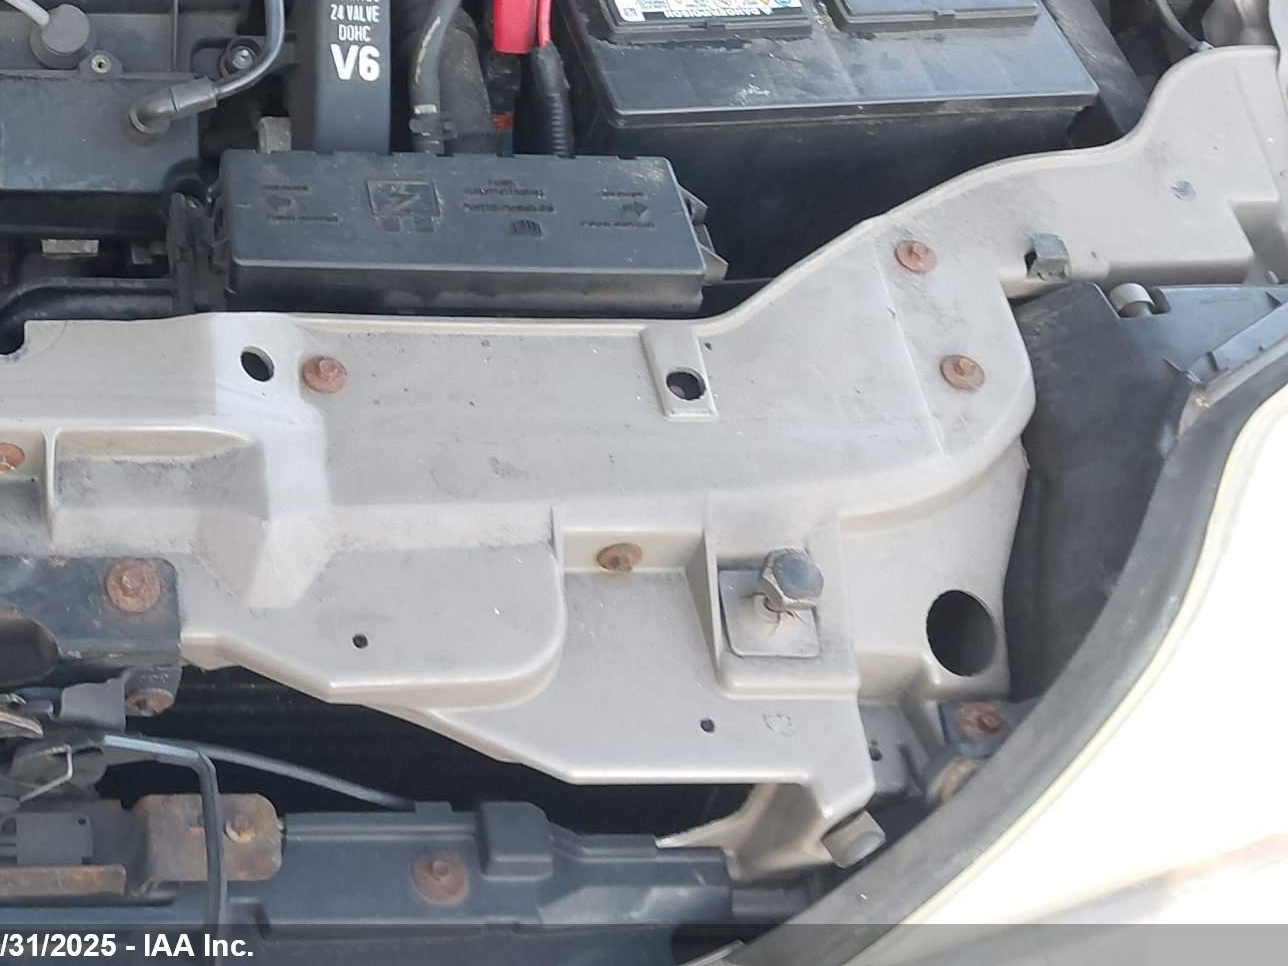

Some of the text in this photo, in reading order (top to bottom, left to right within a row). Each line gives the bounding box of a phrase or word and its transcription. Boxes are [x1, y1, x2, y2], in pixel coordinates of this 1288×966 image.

[330, 4, 380, 22] 24 VALVE
[338, 24, 371, 42] DOHC
[330, 43, 381, 81] V6
